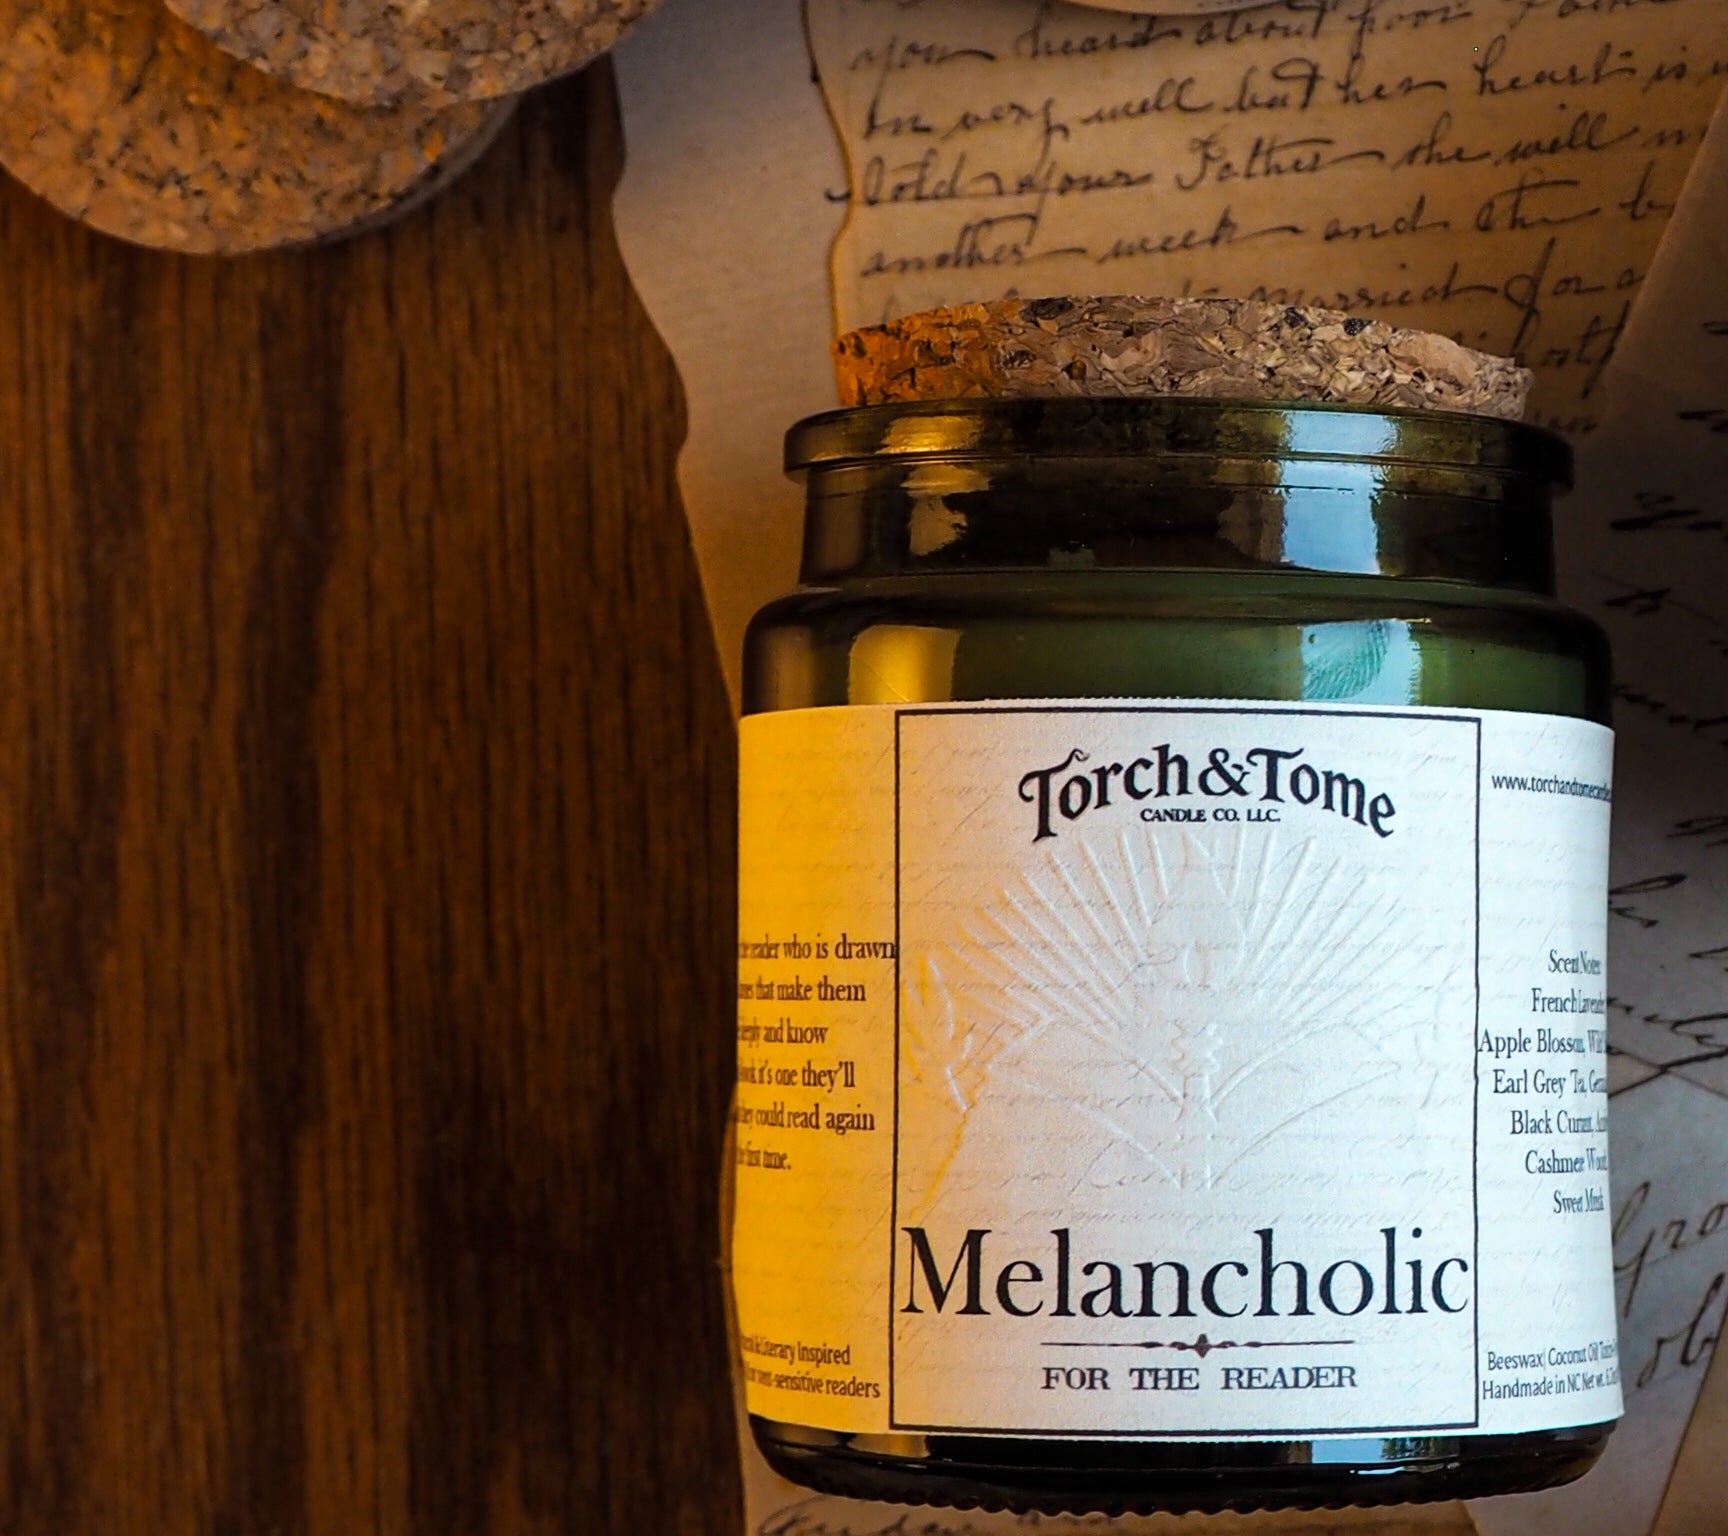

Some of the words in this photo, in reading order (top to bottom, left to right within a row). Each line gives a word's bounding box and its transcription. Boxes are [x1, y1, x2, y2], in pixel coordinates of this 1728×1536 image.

[1018, 743, 1396, 843] Torch&Tome
[1140, 808, 1206, 822] CANDLE
[1213, 808, 1239, 822] CO.
[1246, 808, 1281, 822] LLC.
[816, 933, 828, 959] is
[834, 933, 897, 959] drawn
[817, 975, 866, 1002] them
[1531, 987, 1577, 1014] French
[786, 1017, 828, 1044] know
[1478, 1027, 1532, 1059] Apple
[1493, 1068, 1528, 1094] Earl
[1533, 1069, 1566, 1099] Grey
[787, 1103, 820, 1130] read
[825, 1103, 875, 1135] again
[1510, 1109, 1553, 1136] Black
[900, 1226, 1469, 1317] Melancholic
[798, 1341, 850, 1368] Inspired
[825, 1376, 880, 1398] readers
[1041, 1366, 1109, 1389] FOR
[1130, 1367, 1200, 1389] THE
[1221, 1365, 1358, 1389] READER
[1482, 1377, 1553, 1400] Handmade
